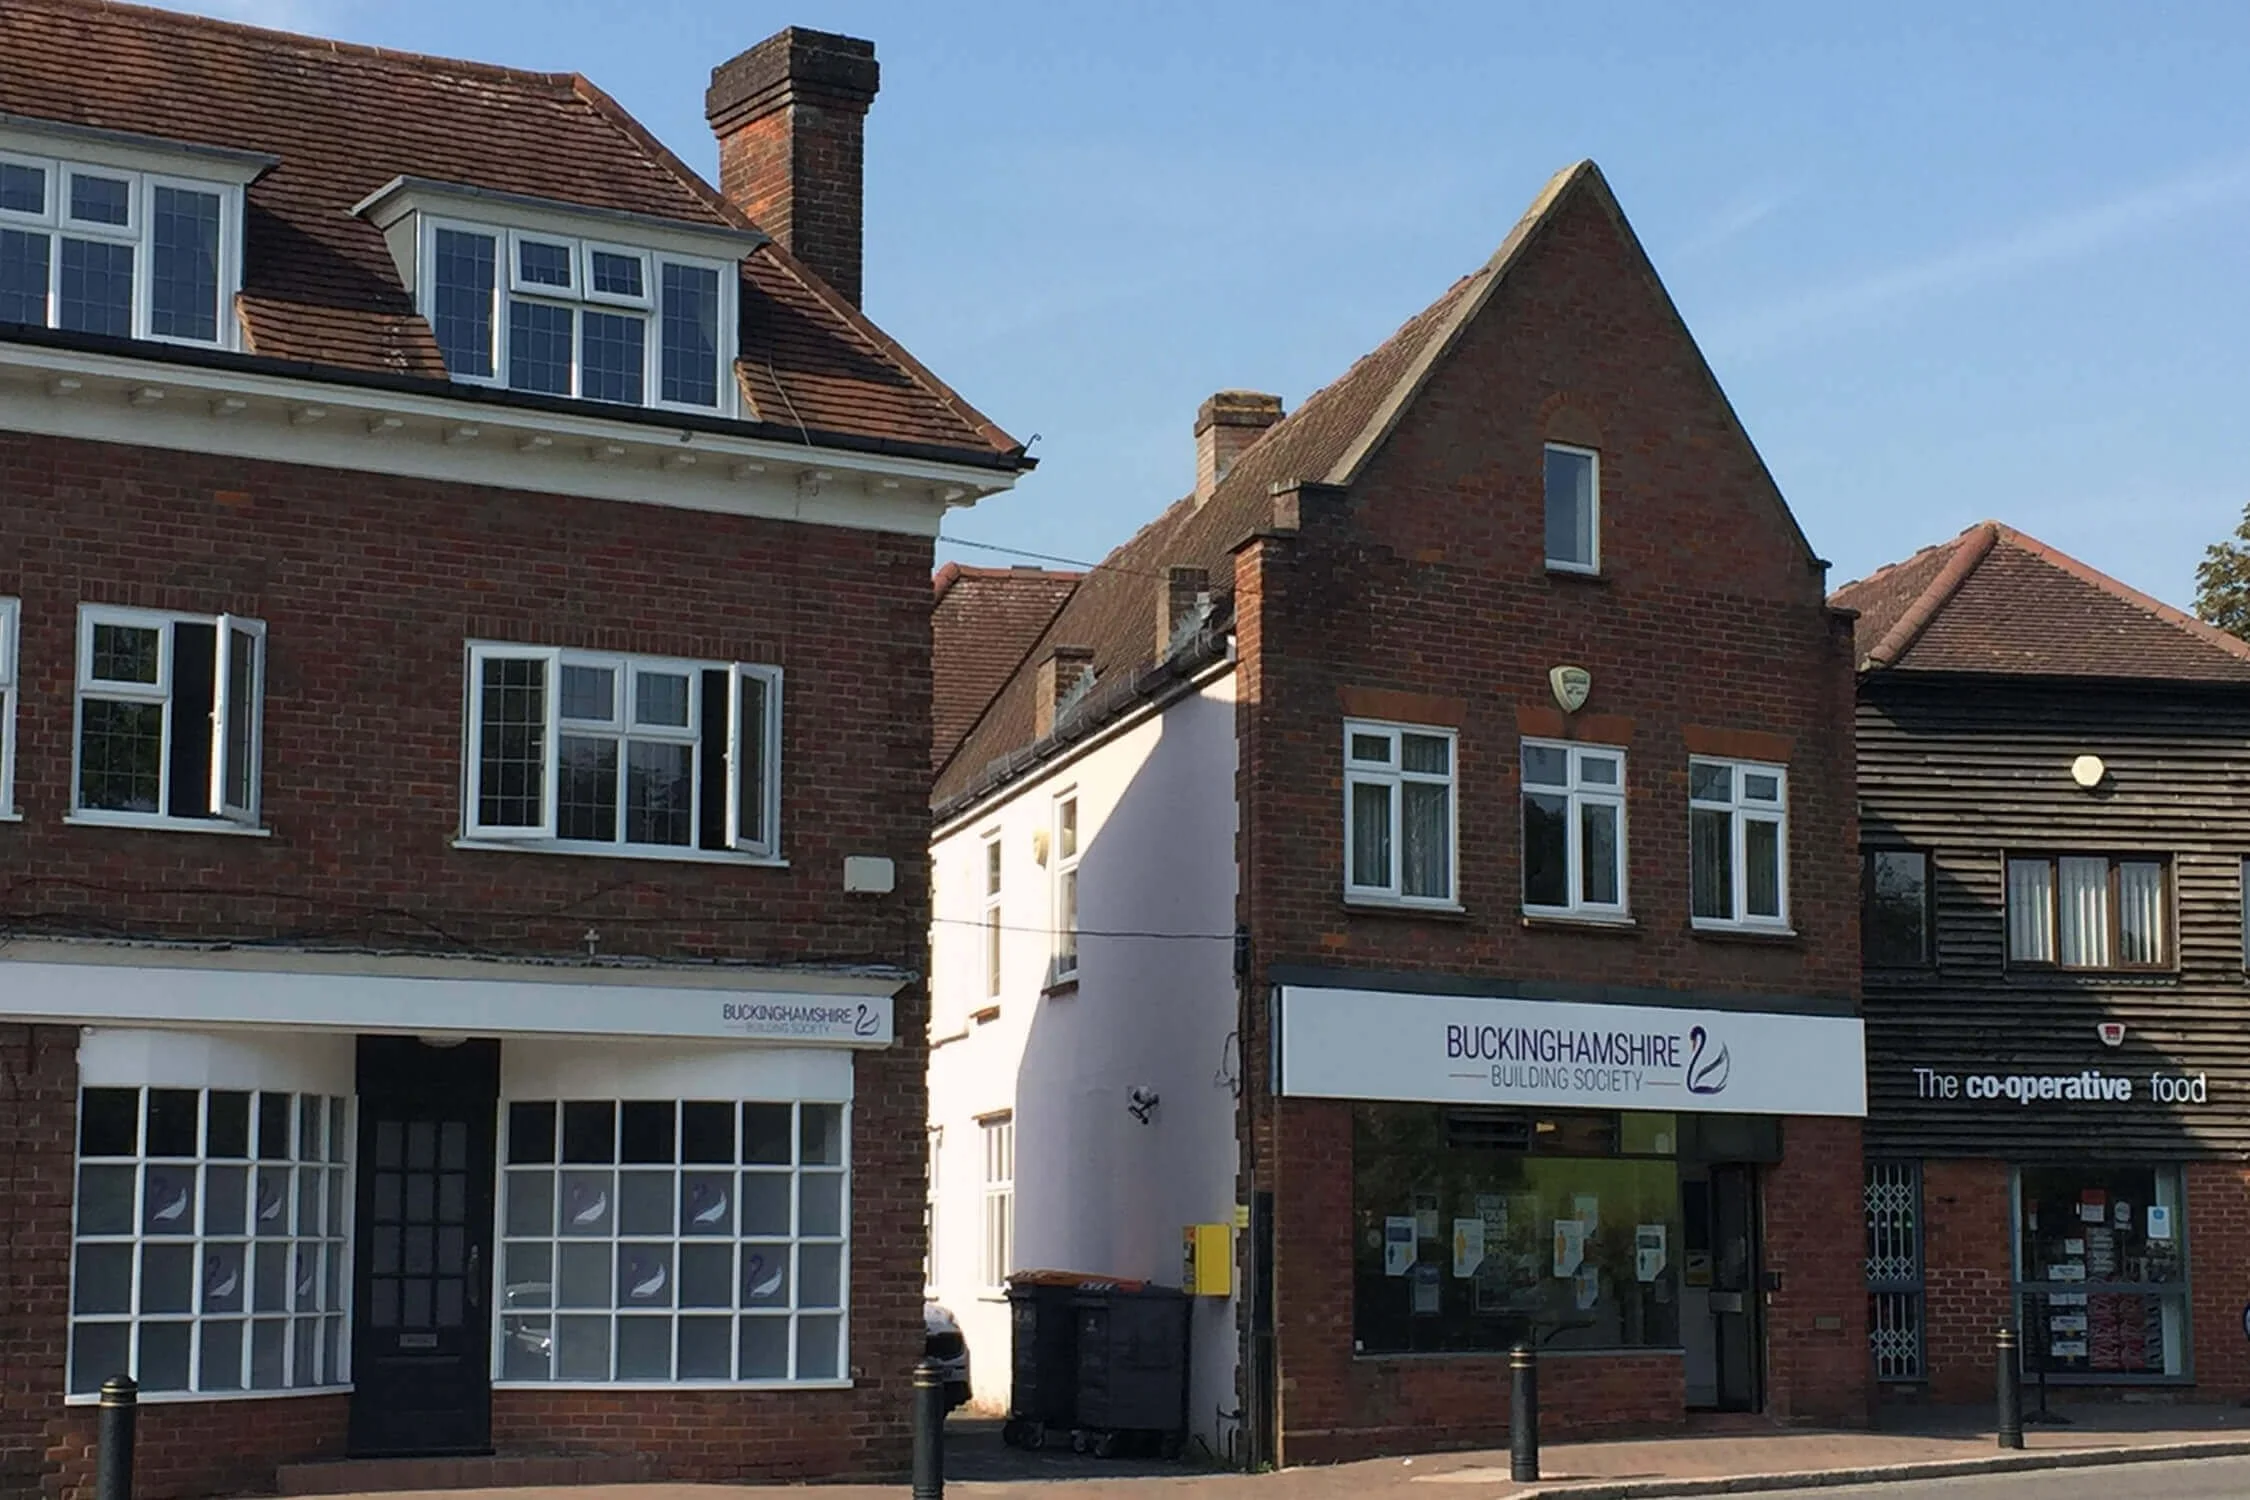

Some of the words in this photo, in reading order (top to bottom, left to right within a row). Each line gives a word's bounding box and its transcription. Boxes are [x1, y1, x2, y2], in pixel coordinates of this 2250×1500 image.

[723, 1003, 852, 1024] BUCKINGHAMSHIRE
[1447, 1025, 1682, 1067] BUCKINGHAMSHIRE
[1491, 1064, 1569, 1090] BUILDING
[1573, 1067, 1643, 1092] SOCIETY
[1912, 1068, 1959, 1098] The
[1965, 1071, 2132, 1104] co-operative
[2151, 1072, 2206, 1102] food
